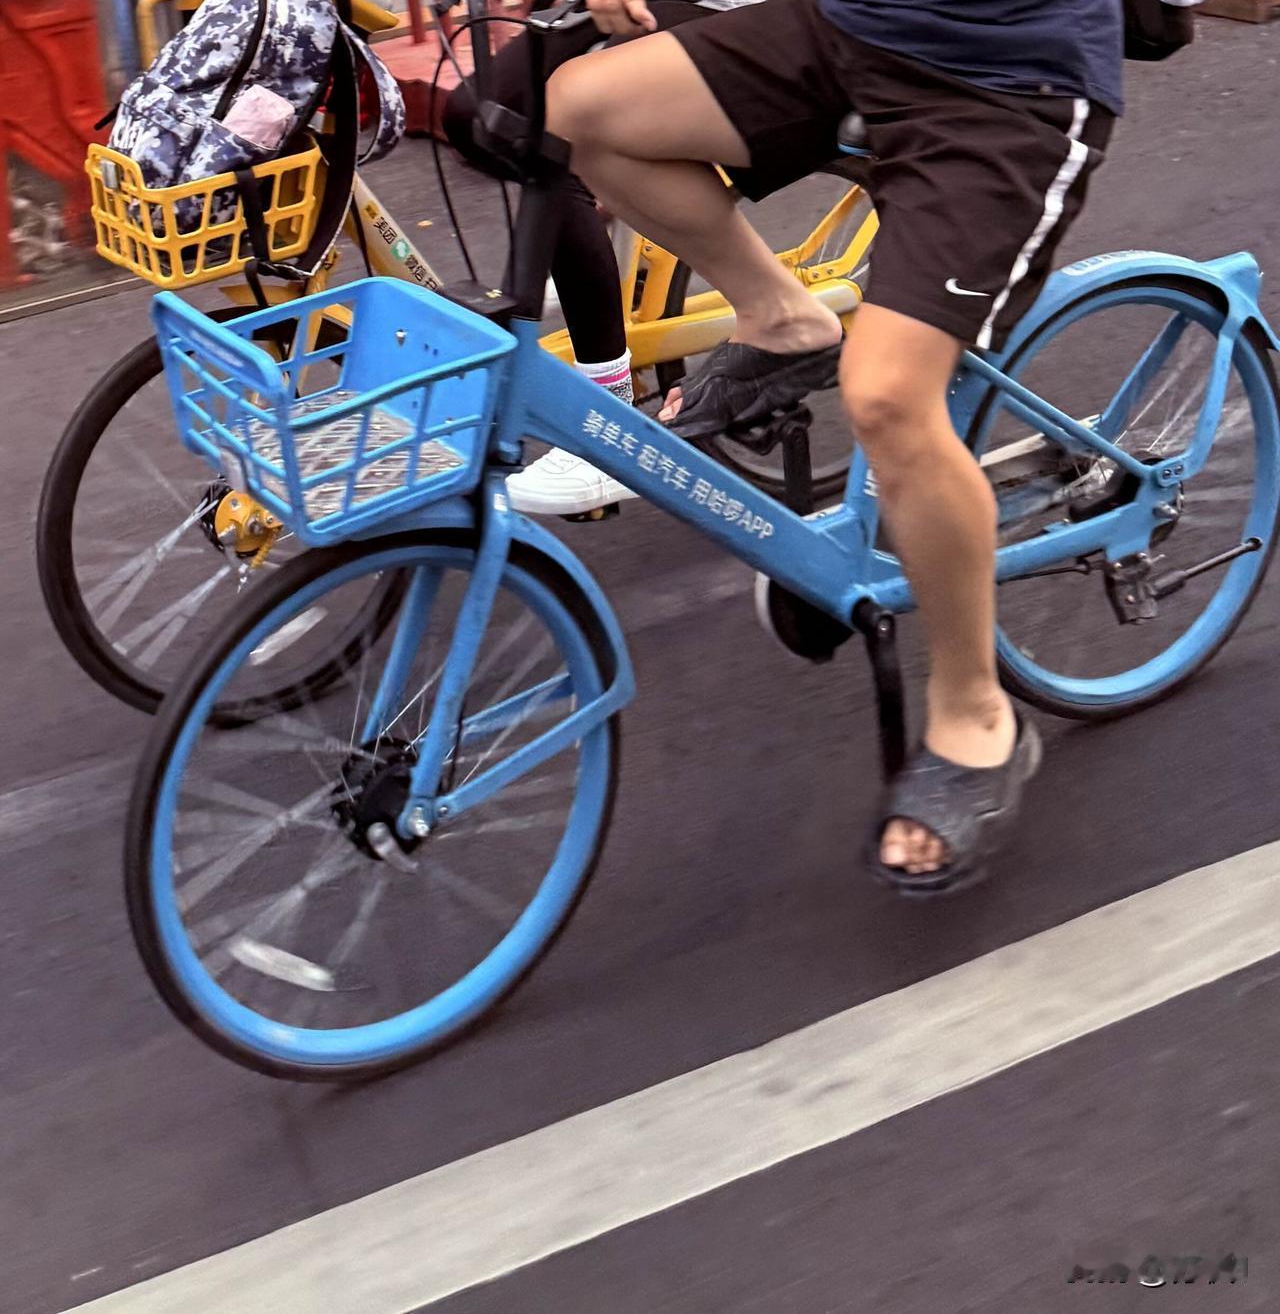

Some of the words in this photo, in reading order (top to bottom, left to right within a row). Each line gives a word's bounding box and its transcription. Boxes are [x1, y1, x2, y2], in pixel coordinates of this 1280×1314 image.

[373, 216, 398, 245] 美团
[581, 409, 639, 456] 骑单车
[636, 444, 693, 491] 租汽车
